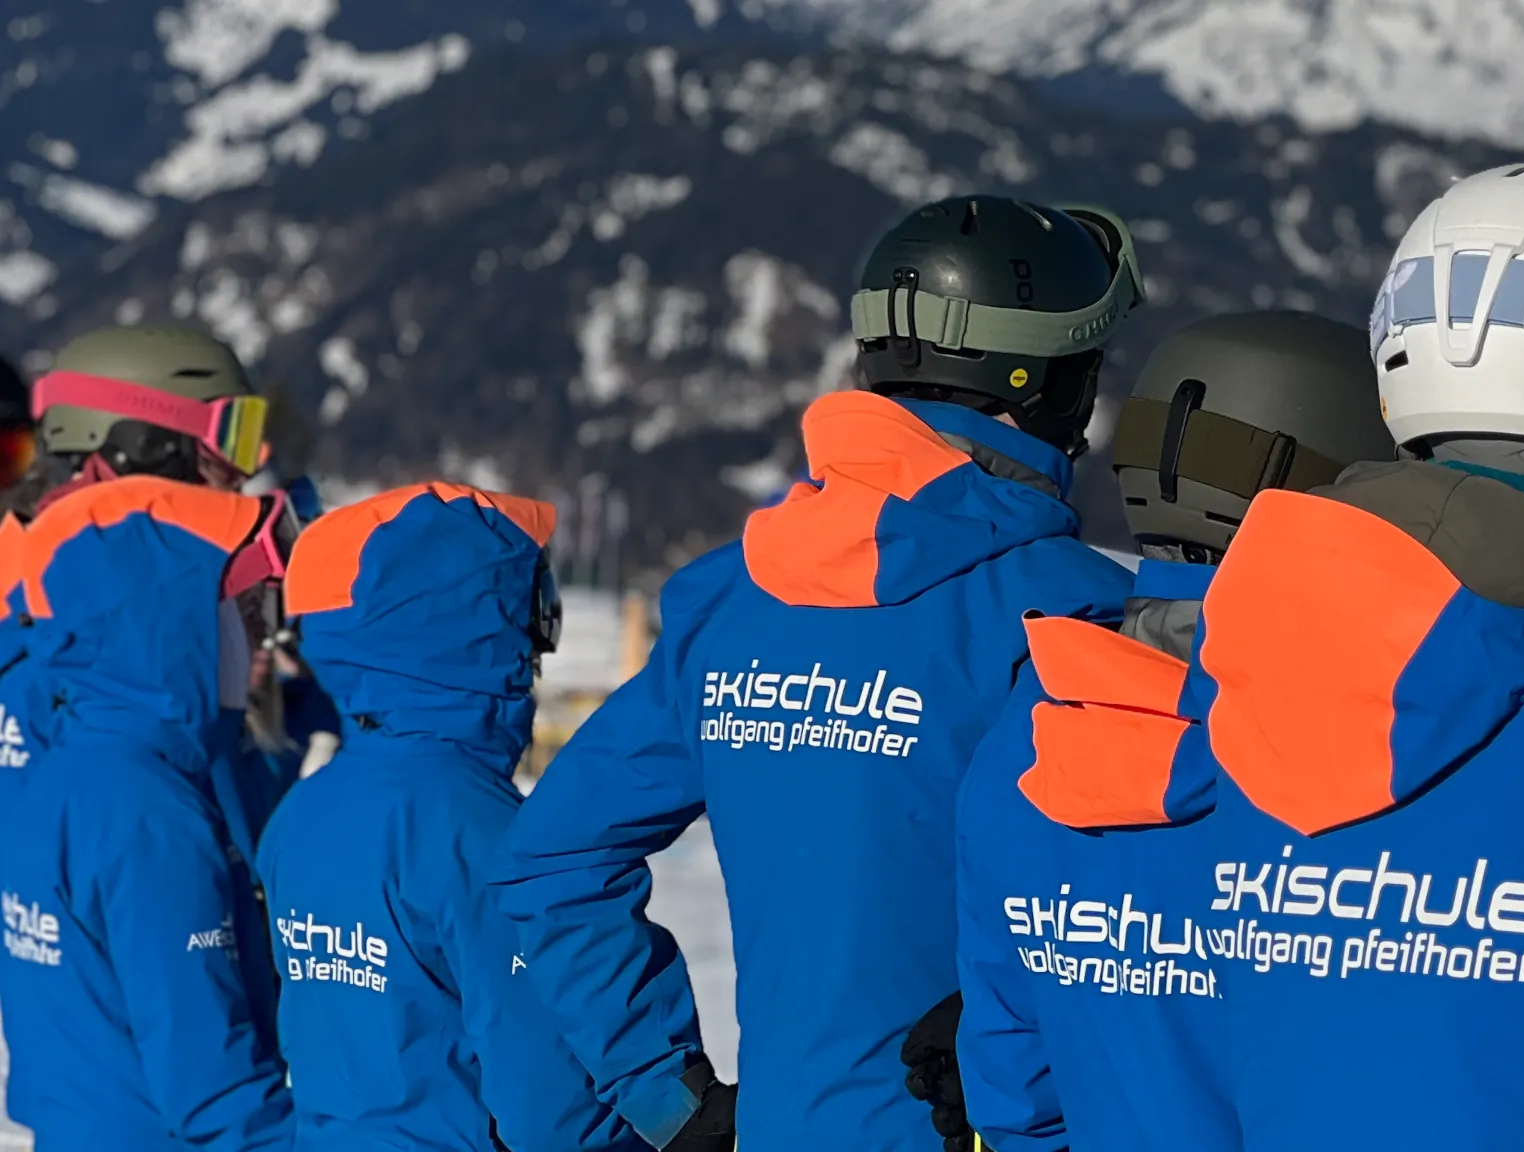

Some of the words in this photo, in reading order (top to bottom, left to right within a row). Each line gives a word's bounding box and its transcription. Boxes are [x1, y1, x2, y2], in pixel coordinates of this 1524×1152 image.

[1009, 259, 1033, 309] po
[703, 659, 922, 724] skischule
[788, 716, 918, 757] pfeifhofer
[306, 956, 388, 993] feifhofer
